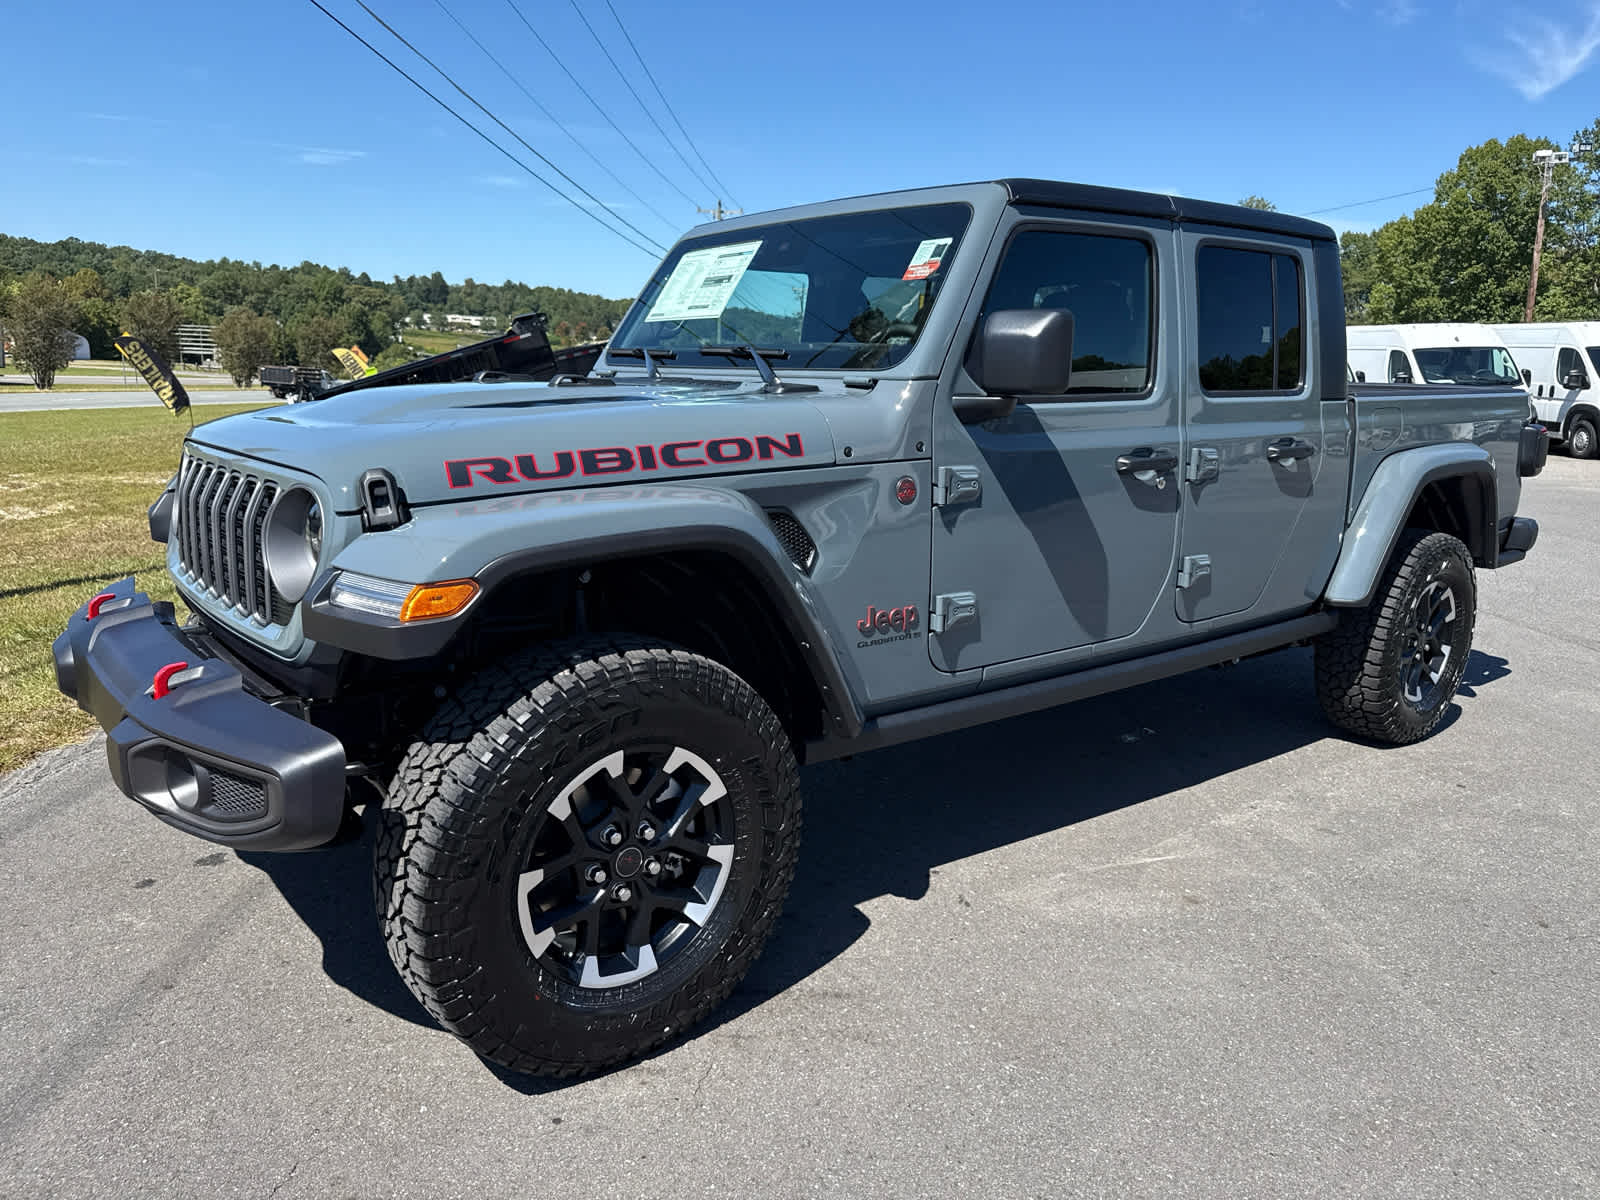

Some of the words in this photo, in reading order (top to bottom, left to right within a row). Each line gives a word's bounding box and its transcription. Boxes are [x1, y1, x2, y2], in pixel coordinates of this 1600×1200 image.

[124, 341, 178, 409] TRAILERS
[444, 433, 804, 488] RUBICON
[856, 605, 919, 634] Jeep
